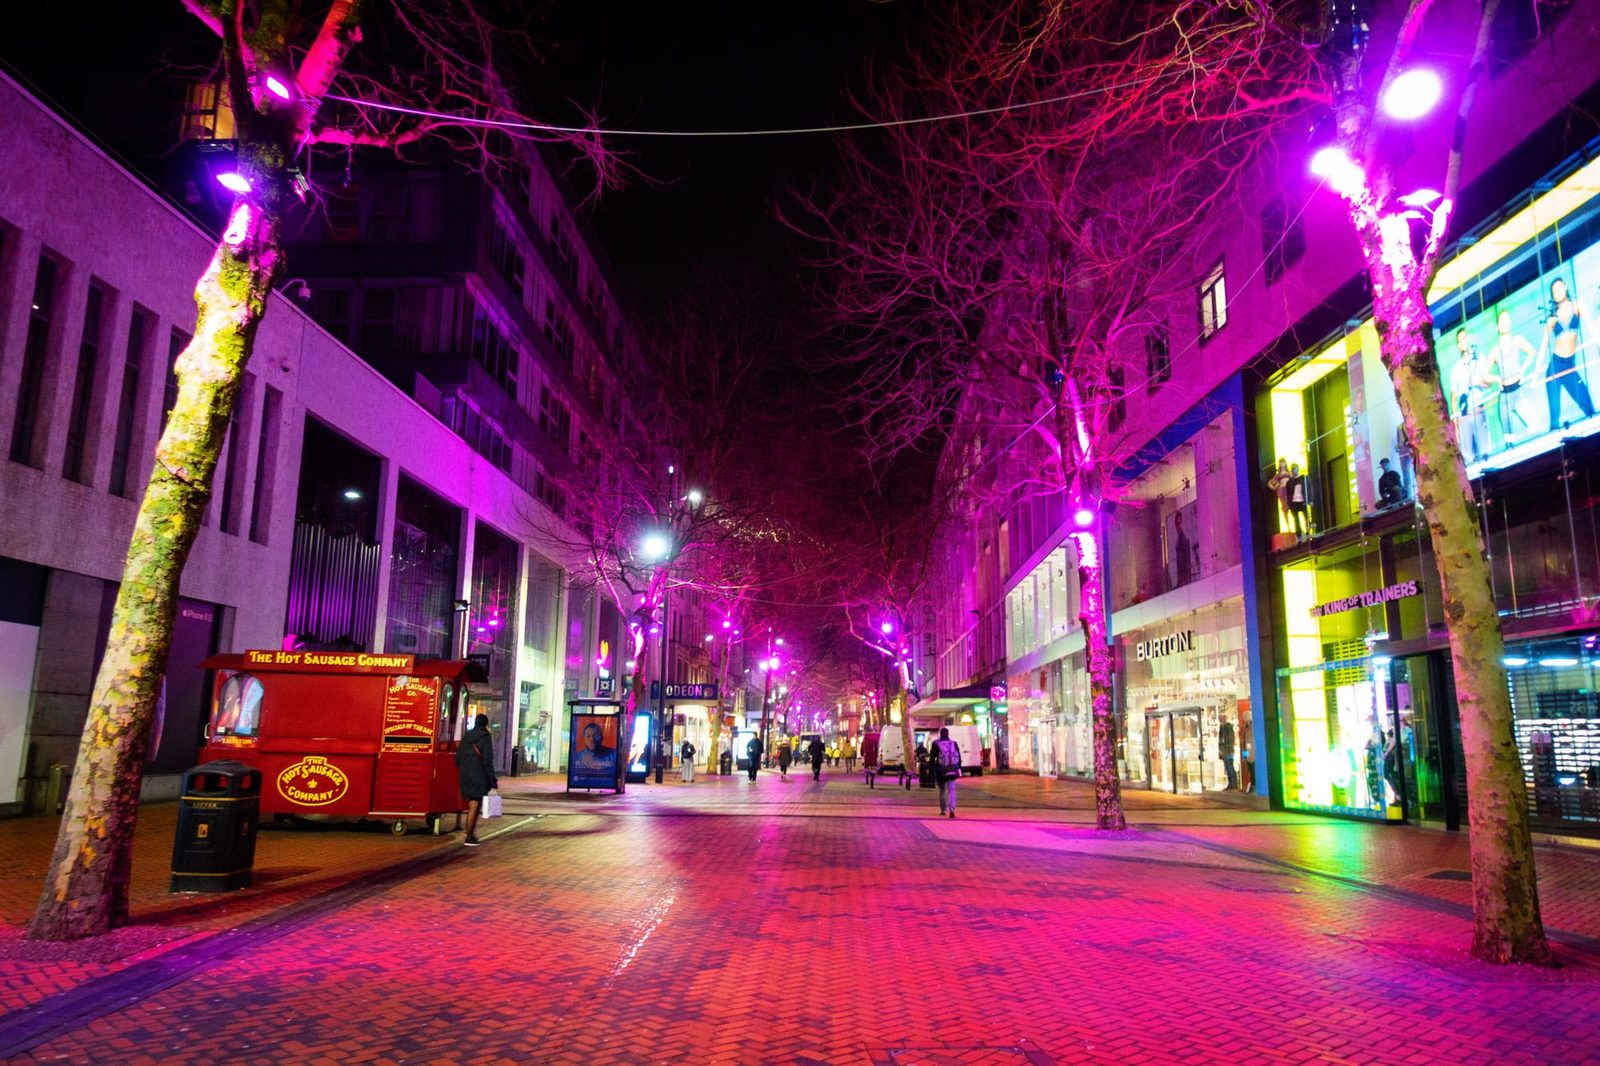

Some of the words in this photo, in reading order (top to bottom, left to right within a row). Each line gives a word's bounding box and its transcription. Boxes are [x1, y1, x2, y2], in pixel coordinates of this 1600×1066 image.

[1324, 600, 1348, 615] KING
[1347, 596, 1360, 607] OF
[1360, 579, 1417, 606] TRAINERS
[1136, 630, 1192, 662] BURTON
[249, 651, 272, 663] THE
[304, 652, 356, 666] SAUSAGE
[357, 654, 409, 668] COMPANY
[389, 684, 404, 694] HOT
[406, 683, 435, 696] SAUSAGE
[666, 685, 703, 697] ODEON
[282, 765, 302, 784] HOT
[301, 764, 344, 786] SAUSAGE
[287, 785, 334, 802] COMPANY
